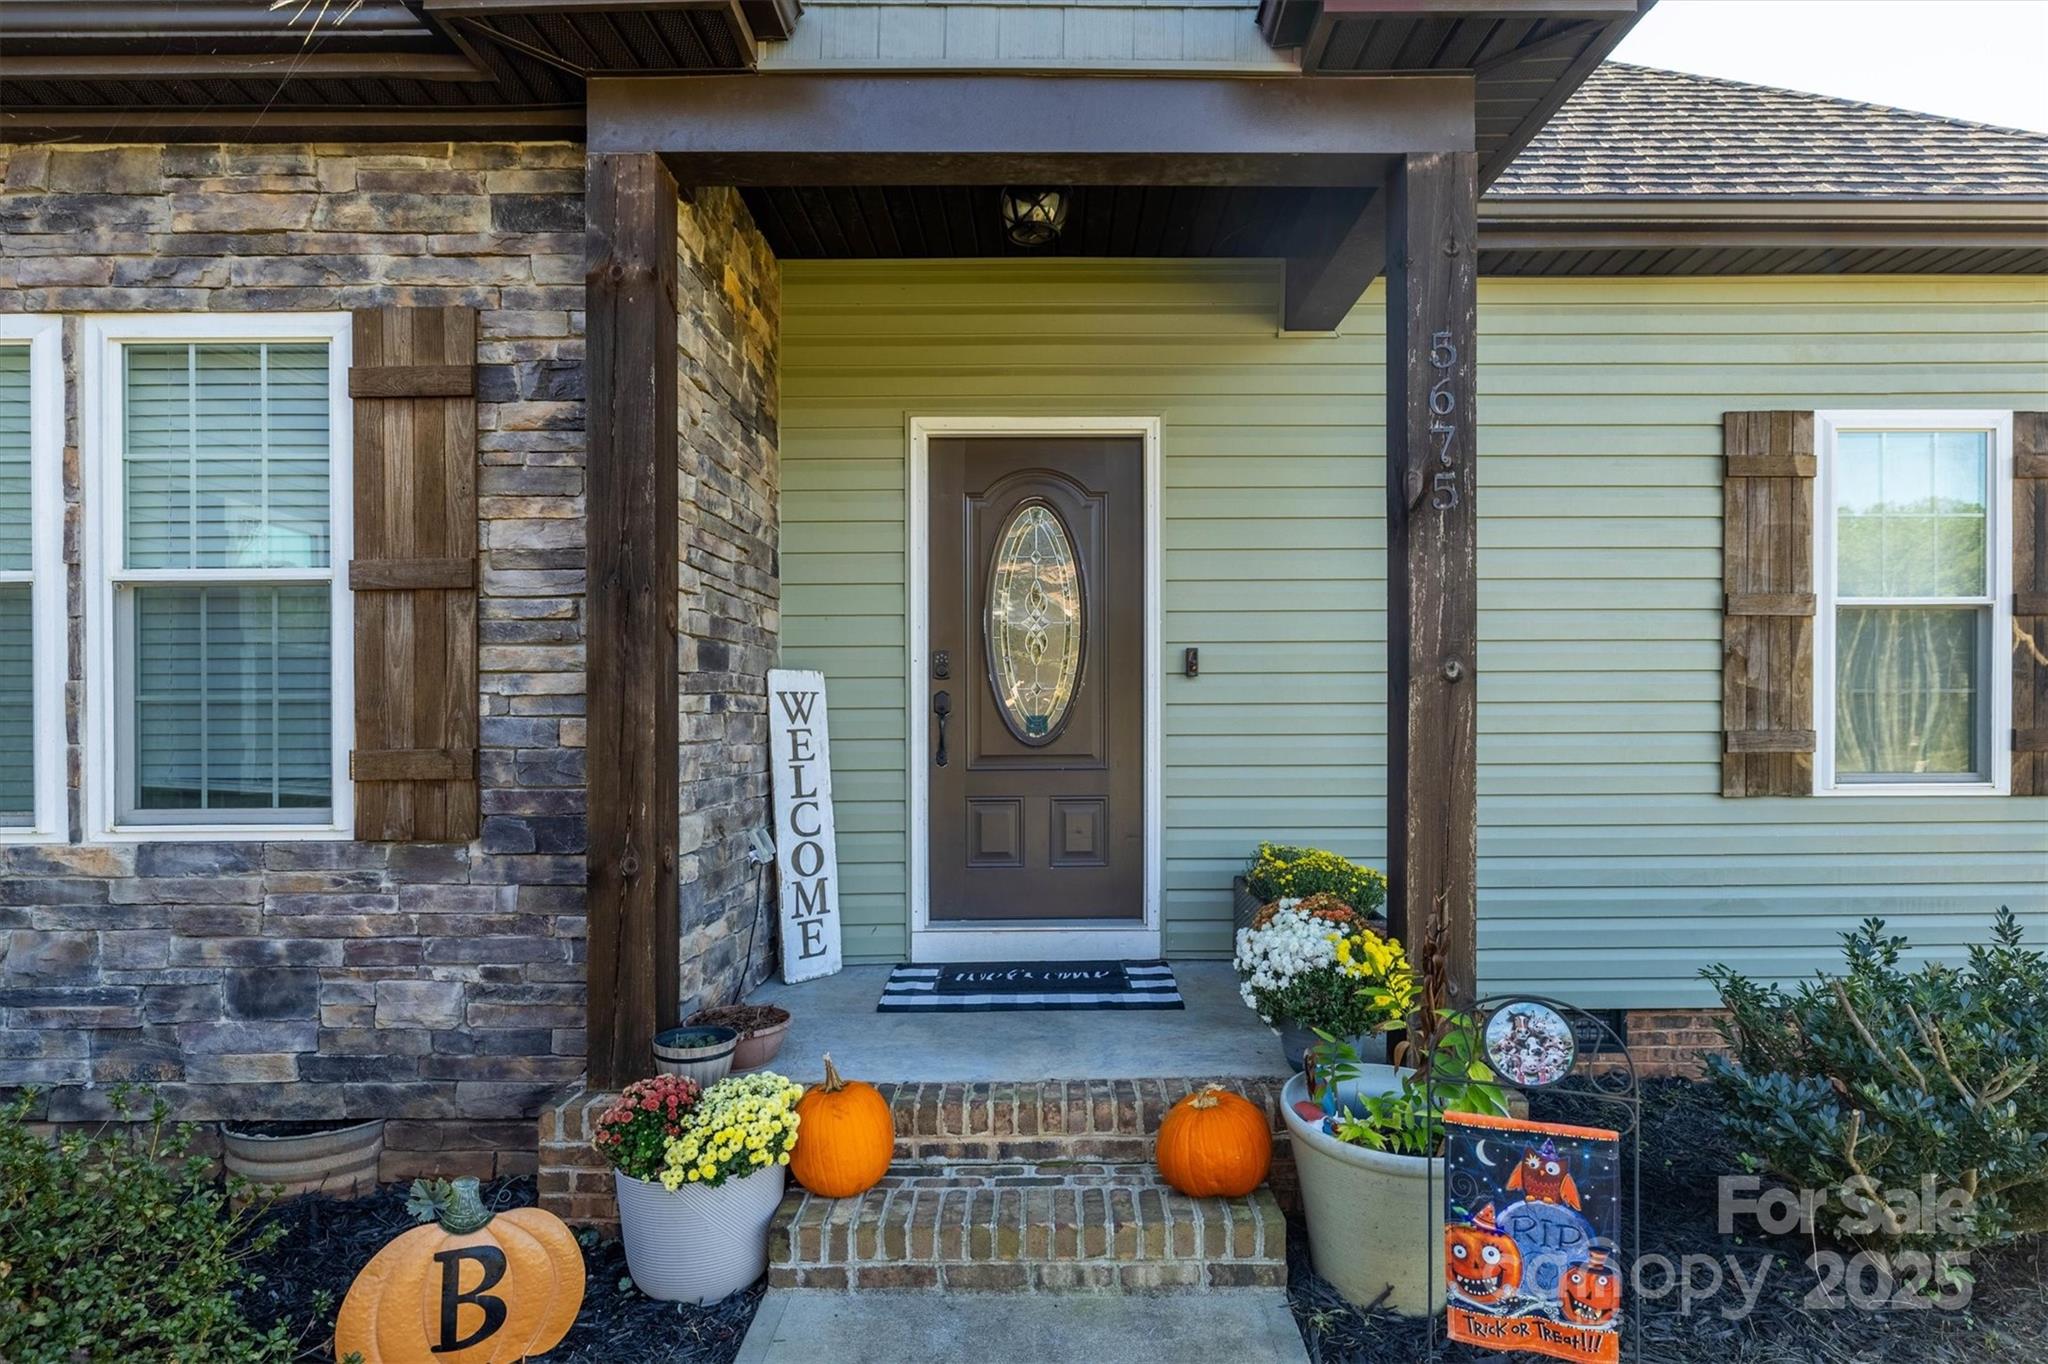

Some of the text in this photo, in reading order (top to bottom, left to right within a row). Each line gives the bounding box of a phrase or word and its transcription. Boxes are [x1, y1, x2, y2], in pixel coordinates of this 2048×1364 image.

[1429, 331, 1458, 510] 5675
[776, 691, 831, 961] WELCOME
[430, 1245, 508, 1353] B
[1510, 1215, 1584, 1252] RIP
